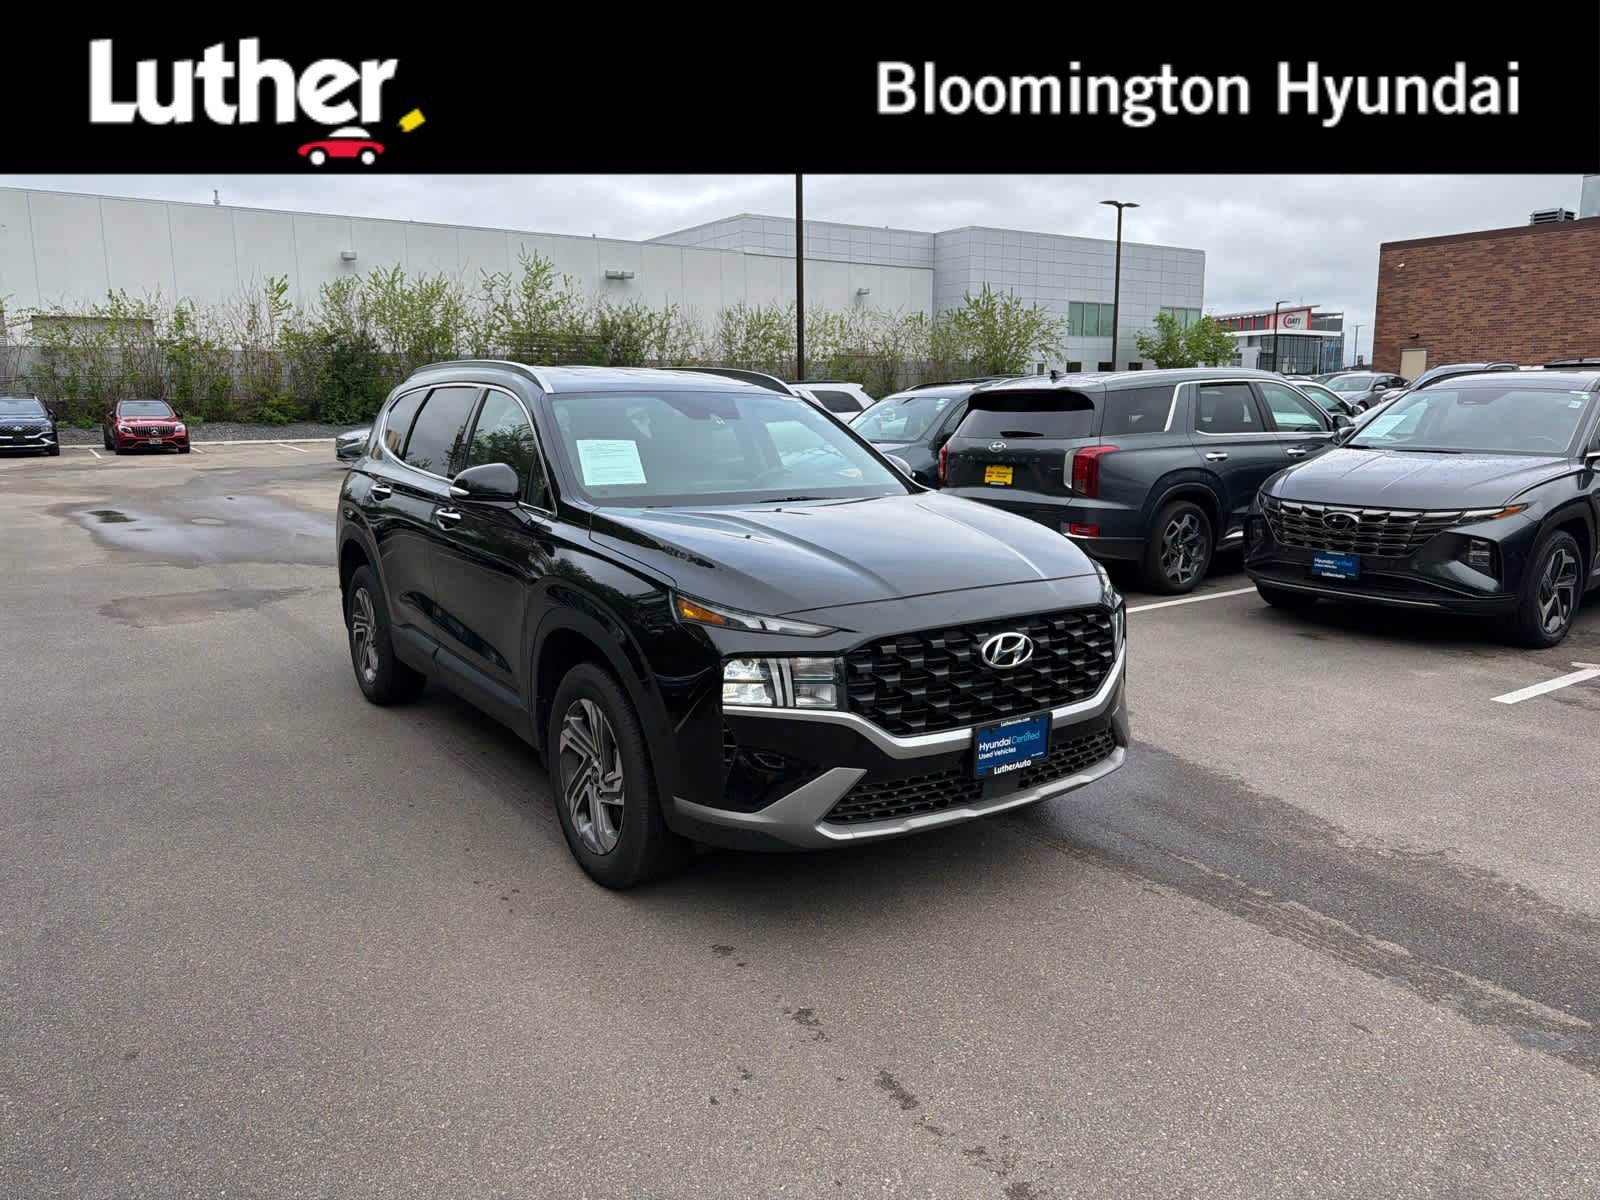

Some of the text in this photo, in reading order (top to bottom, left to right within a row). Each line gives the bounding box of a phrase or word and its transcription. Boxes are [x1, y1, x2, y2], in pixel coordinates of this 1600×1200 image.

[979, 729, 1040, 752] Hyundai Certified
[978, 747, 1016, 760] Used Vehicles
[994, 760, 1032, 775] LutherAuto
